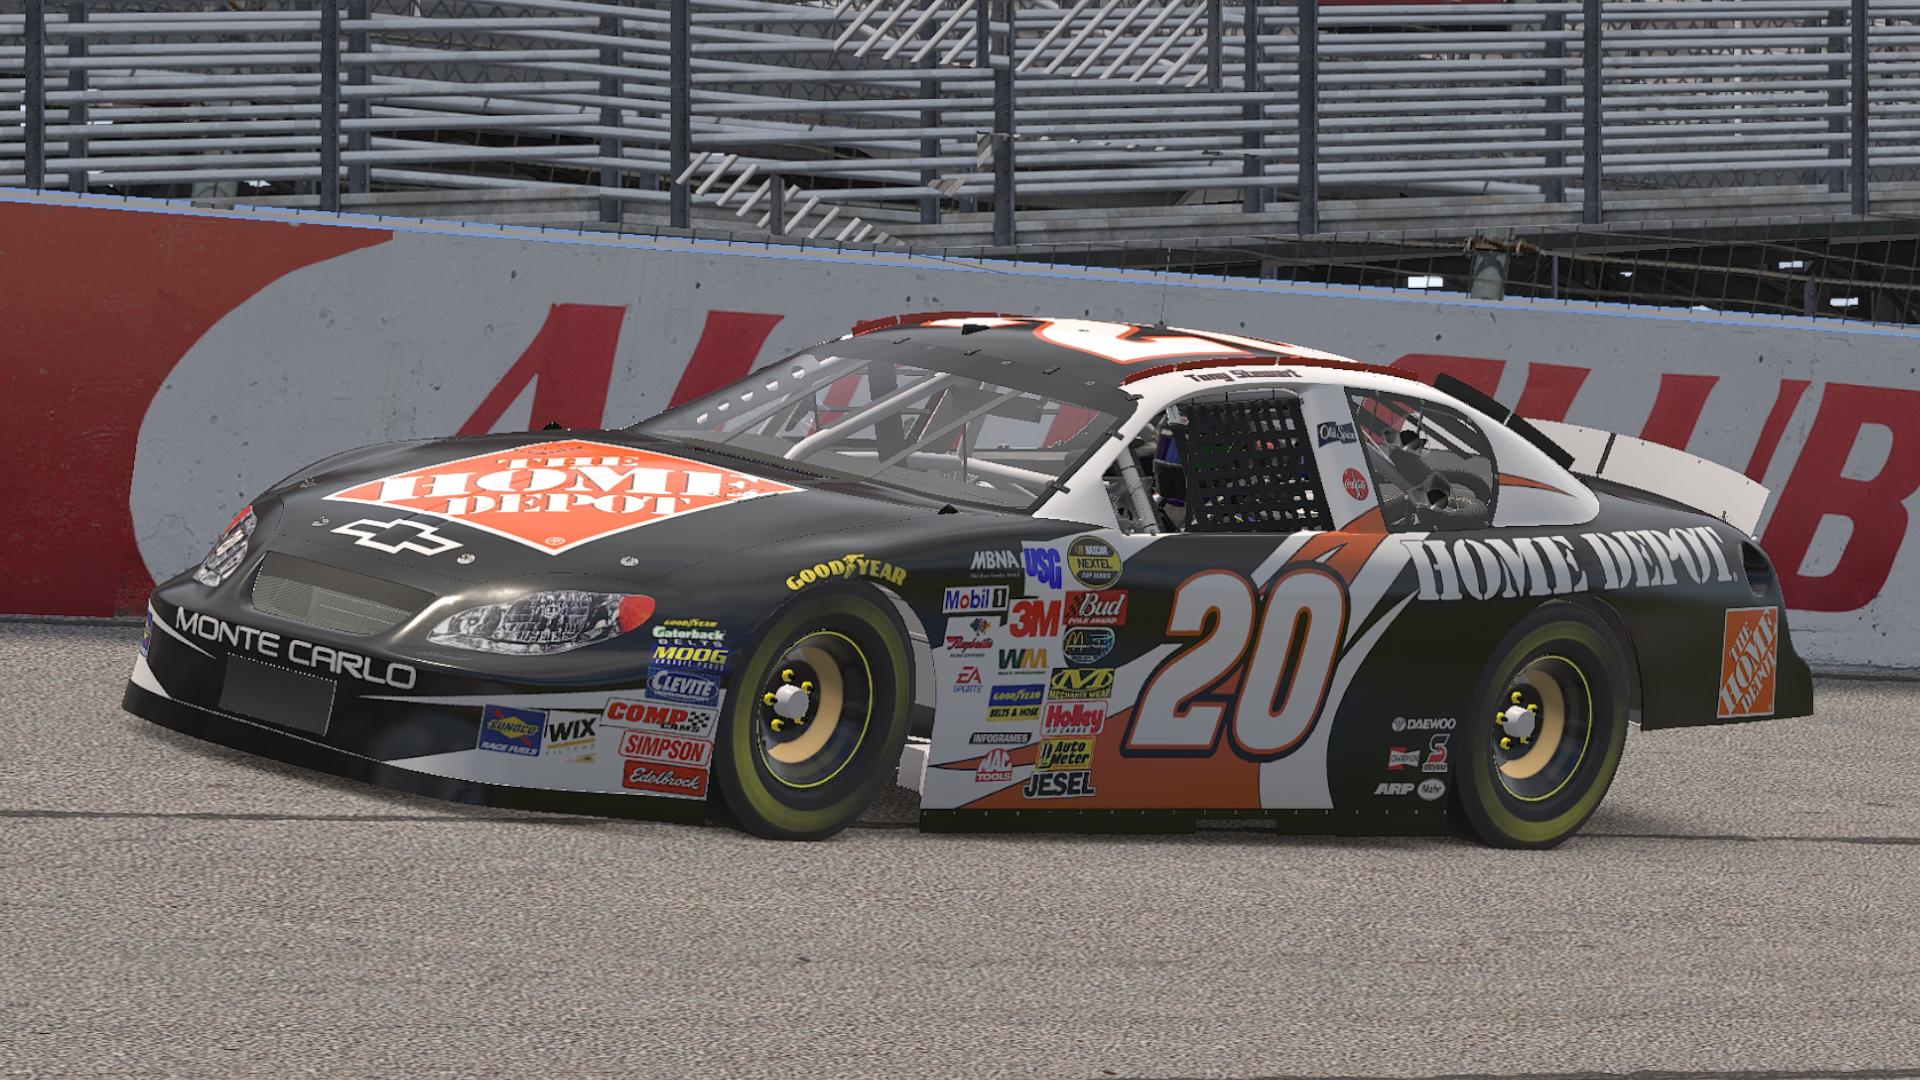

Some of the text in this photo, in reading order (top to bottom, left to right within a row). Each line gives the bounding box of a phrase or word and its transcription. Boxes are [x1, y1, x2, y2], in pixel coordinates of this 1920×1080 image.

[1184, 368, 1303, 383] Tony Stewart
[497, 456, 638, 469] THE
[378, 465, 762, 500] HOME
[431, 492, 692, 516] DEPOT
[970, 550, 1020, 570] MBNA
[1023, 547, 1062, 590] USG
[1077, 557, 1111, 569] NEXTEL
[1400, 535, 1589, 601] HOME
[785, 553, 908, 591] GOODYEAR
[944, 588, 990, 610] Mobil
[1079, 592, 1126, 617] Bud
[1009, 599, 1062, 639] 3M
[652, 625, 726, 641] Gatorback
[1728, 620, 1752, 662] THE
[175, 606, 281, 658] MONTE
[288, 638, 417, 691] CARLO
[652, 645, 729, 665] MOOG
[999, 649, 1047, 669] WM
[1124, 566, 1348, 757] 20
[1719, 607, 1778, 716] HOME
[651, 670, 715, 697] CLEVITE
[955, 666, 982, 684] EA
[1740, 647, 1777, 714] DEPOT
[953, 684, 983, 694] SPORTS
[993, 688, 1041, 702] GOODYEAR
[607, 702, 689, 726] COMP
[989, 708, 1009, 718] BELTS
[1045, 704, 1104, 734] Holley
[1406, 717, 1457, 730] DAEWOO
[487, 719, 539, 736] SUNOCO
[549, 717, 597, 743] WIX
[972, 732, 1029, 744] INFOGRAMES
[481, 740, 508, 753] RACE
[508, 743, 539, 756] FUELS
[625, 734, 704, 763] SIMPSON
[1055, 740, 1086, 752] Auto
[978, 750, 1012, 773] MAC
[1051, 752, 1090, 765] Meter
[629, 767, 700, 791] Edelbrock
[976, 772, 1012, 782] TOOLS
[1024, 771, 1095, 798] JESEL
[1374, 783, 1416, 796] ARP
